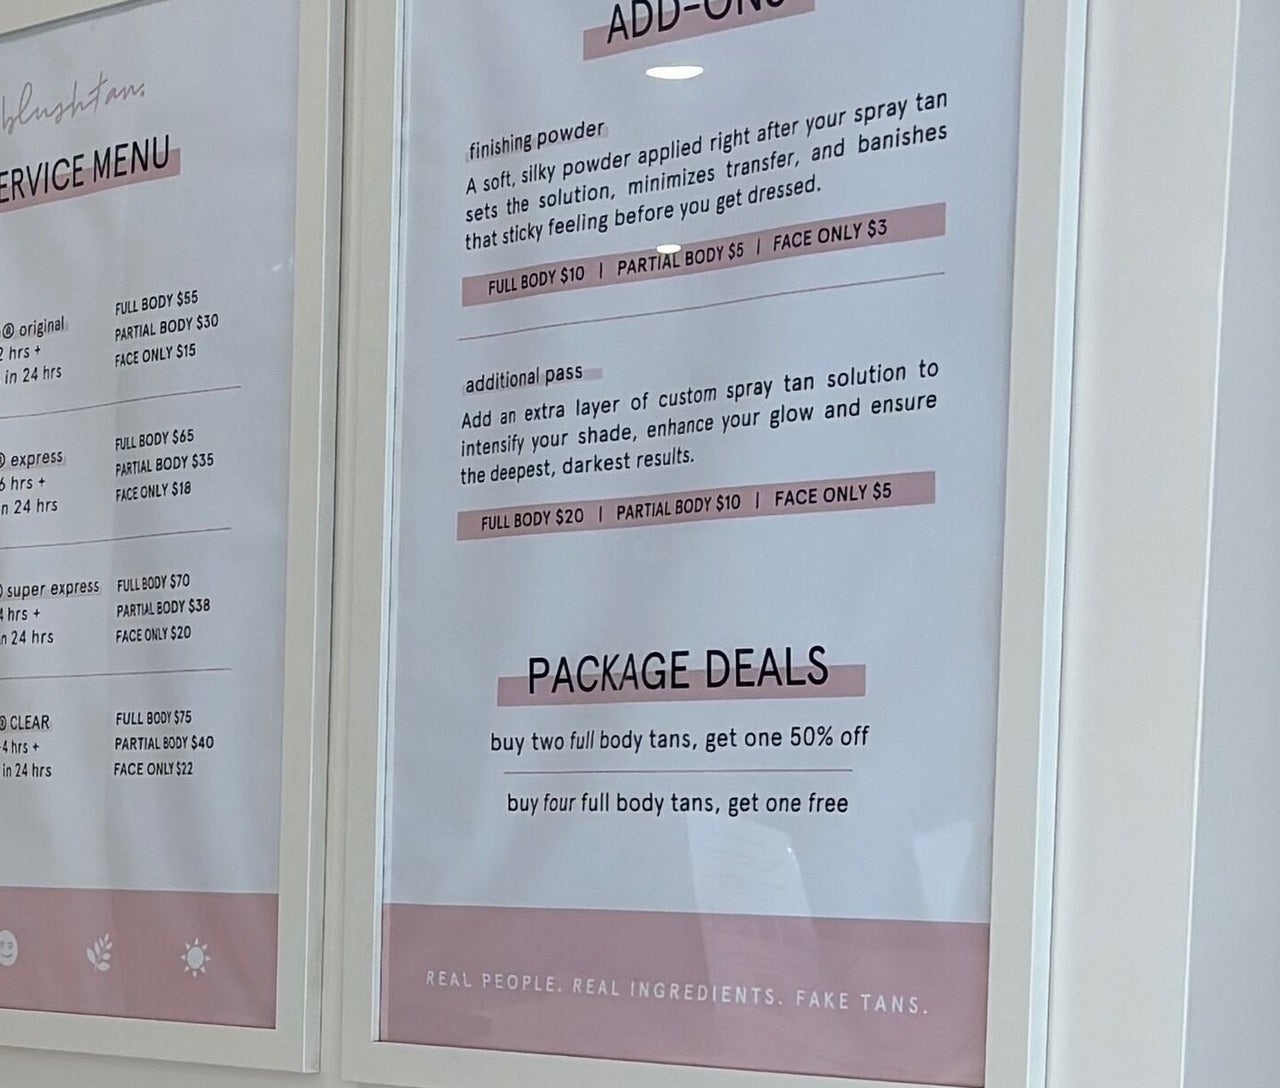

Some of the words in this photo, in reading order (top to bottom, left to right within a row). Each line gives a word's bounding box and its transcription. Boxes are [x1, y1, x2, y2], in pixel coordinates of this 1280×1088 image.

[466, 177, 476, 195] A
[483, 171, 515, 191] soft,
[522, 163, 555, 183] silky
[563, 152, 631, 181] powder
[638, 136, 702, 167] applied
[711, 128, 750, 153] right
[757, 120, 799, 142] after
[806, 111, 846, 138] your
[854, 99, 907, 126] spray
[916, 93, 947, 112] tan
[470, 134, 532, 160] finishing
[537, 121, 605, 150] powder
[93, 134, 169, 183] MENU
[465, 230, 497, 250] that
[502, 222, 543, 244] sticky
[548, 213, 608, 235] feeling
[615, 204, 674, 226] before
[680, 199, 709, 221] you
[716, 189, 742, 214] get
[748, 174, 821, 204] dressed.
[487, 276, 517, 296] FULL
[521, 269, 556, 290] BODY
[560, 266, 584, 284] $10
[618, 252, 682, 276] PARTIAL
[685, 245, 724, 266] BODY
[728, 242, 743, 261] $5
[774, 230, 812, 252] FACE
[818, 222, 862, 245] ONLY
[867, 219, 887, 240] $3
[116, 300, 138, 316] FULL
[142, 293, 173, 311] BODY
[177, 290, 198, 307] $55
[19, 315, 64, 338] original
[115, 323, 156, 342] PARTIAL
[160, 317, 193, 334] BODY
[196, 314, 218, 330] $30
[9, 347, 30, 360] hrs
[115, 351, 139, 367] FACE
[142, 346, 173, 362] ONLY
[176, 343, 196, 358] $15
[5, 370, 17, 384] in
[23, 367, 38, 382] 24
[43, 365, 62, 380] hrs
[466, 367, 539, 393] additional
[546, 366, 582, 386] pass
[116, 436, 136, 451] FULL
[139, 431, 169, 447] BODY
[172, 429, 194, 444] $65
[9, 451, 63, 469] express
[116, 460, 152, 476] PARTIAL
[156, 456, 188, 471] BODY
[192, 453, 214, 469] $35
[461, 467, 485, 485] the
[491, 459, 555, 483] deepest,
[563, 452, 630, 474] darkest
[637, 447, 694, 468] results.
[116, 487, 138, 502] FACE
[140, 483, 168, 499] ONLY
[172, 481, 191, 496] $18
[482, 510, 510, 531] FULL
[514, 507, 551, 528] BODY
[556, 508, 584, 526] $20
[617, 497, 672, 520] PARTIAL
[675, 496, 712, 515] BODY
[716, 494, 741, 512] $10
[776, 488, 817, 506] FACE
[823, 484, 867, 503] ONLY
[873, 481, 892, 501] $5
[529, 651, 691, 694] PACKAGE
[706, 645, 831, 688] DEALS
[10, 715, 49, 730] CLEAR
[116, 712, 143, 725] FULL
[147, 711, 171, 725] BODY
[174, 710, 192, 725] $75
[12, 739, 28, 754] hrs
[115, 737, 161, 750] PARTIAL
[163, 736, 188, 749] BODY
[191, 735, 214, 750] $40
[491, 733, 524, 756] buy
[531, 733, 564, 750] two
[570, 730, 594, 749] full
[600, 730, 643, 753] body
[649, 730, 697, 750] tans,
[706, 728, 737, 753] get
[745, 732, 782, 747] one
[791, 726, 833, 746] 50%
[841, 725, 870, 746] off
[3, 763, 12, 777] in
[16, 763, 28, 777] 24
[32, 763, 52, 777] hrs
[114, 763, 143, 776] FACE
[147, 762, 174, 775] ONLY
[176, 761, 193, 776] $22
[508, 793, 538, 816] buy
[544, 793, 576, 811] four
[582, 792, 609, 811] full
[617, 792, 664, 817] body
[671, 793, 720, 814] tans,
[728, 793, 759, 817] get
[766, 797, 801, 812] one
[809, 792, 848, 813] free
[425, 970, 472, 987] REAL
[482, 973, 561, 992] PEOPLE.
[573, 978, 619, 996] REAL
[631, 981, 782, 1005] INGREDIENTS.
[797, 990, 848, 1009] FAKE
[860, 994, 927, 1016] TANS.
